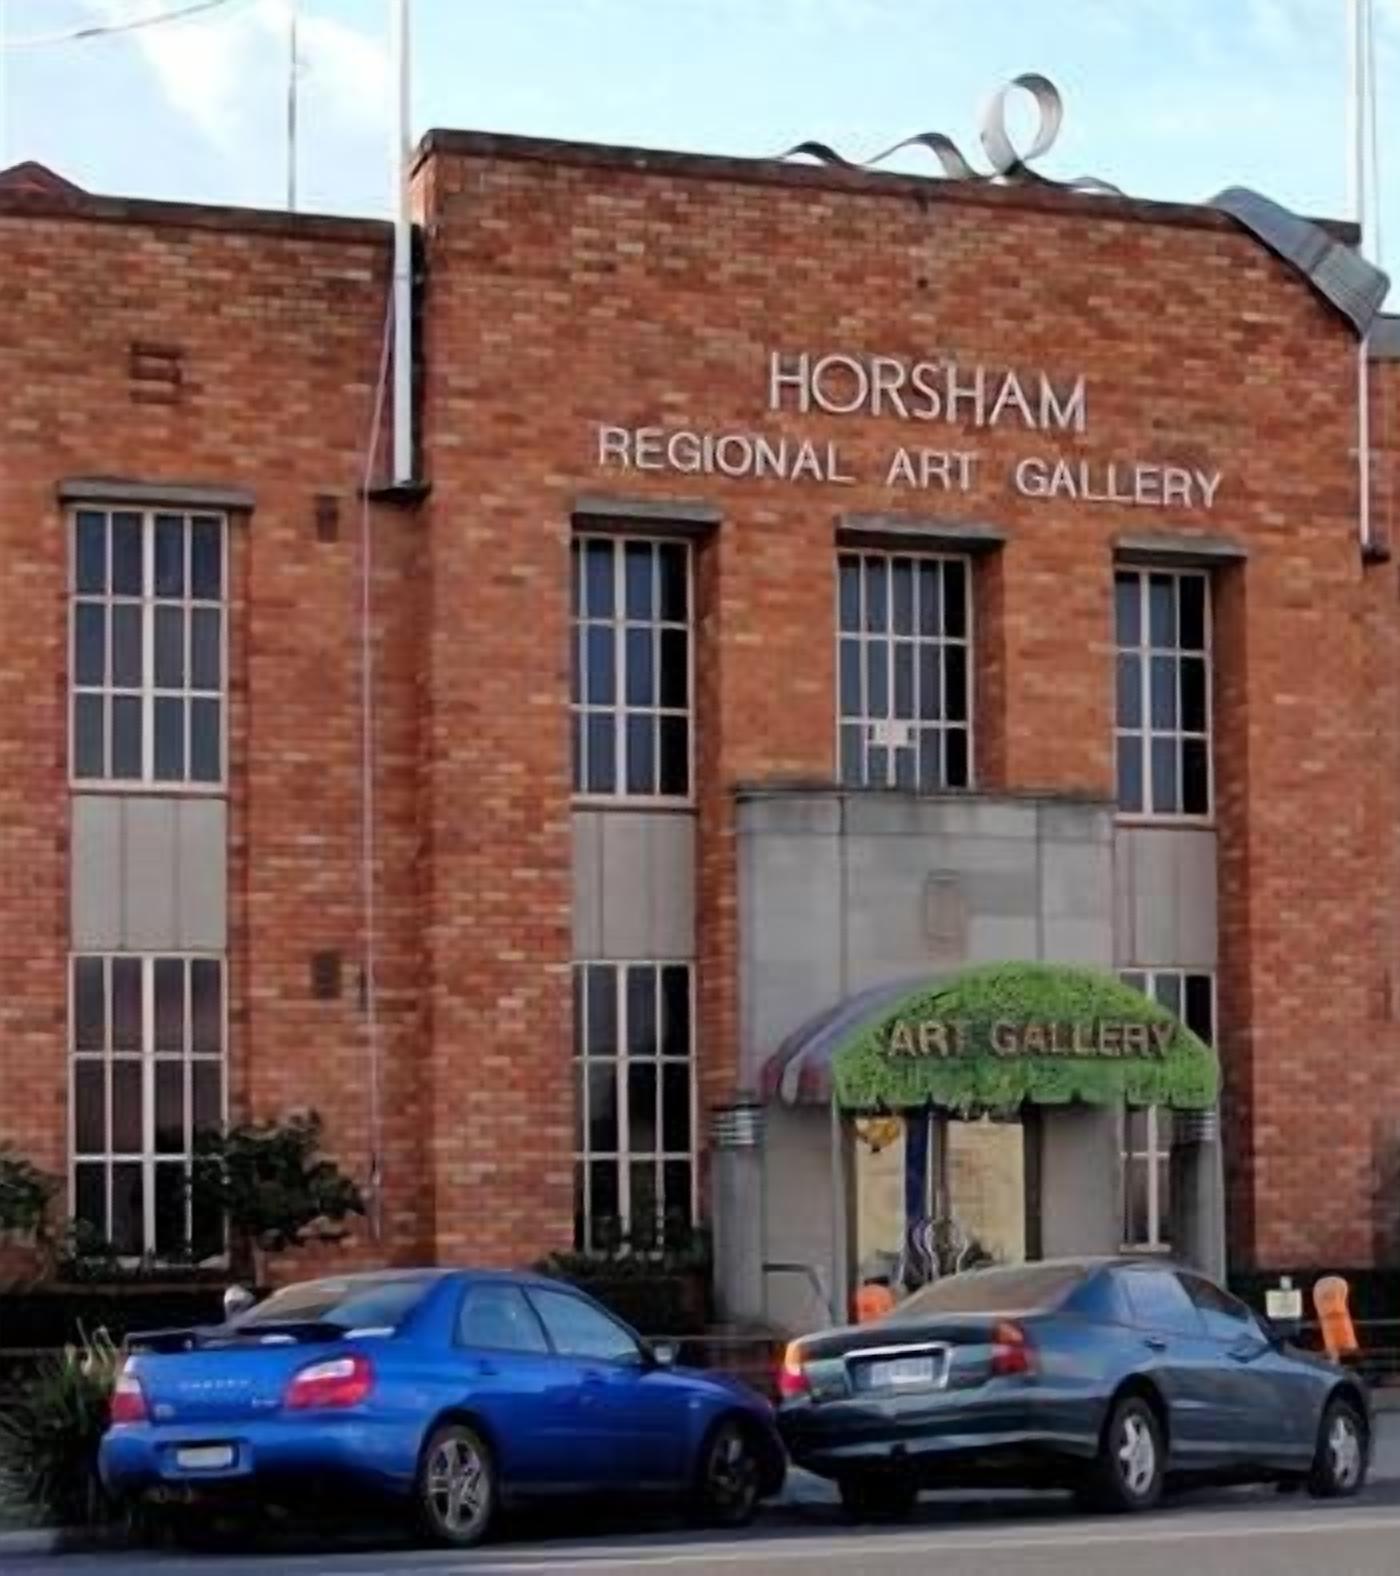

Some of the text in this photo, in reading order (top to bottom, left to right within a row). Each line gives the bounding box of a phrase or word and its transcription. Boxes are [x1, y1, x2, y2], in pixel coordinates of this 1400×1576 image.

[769, 350, 1087, 432] HORSHAM
[597, 426, 1224, 508] REGIONAL ART GALLERY
[886, 1020, 1177, 1059] ART GALLERY
